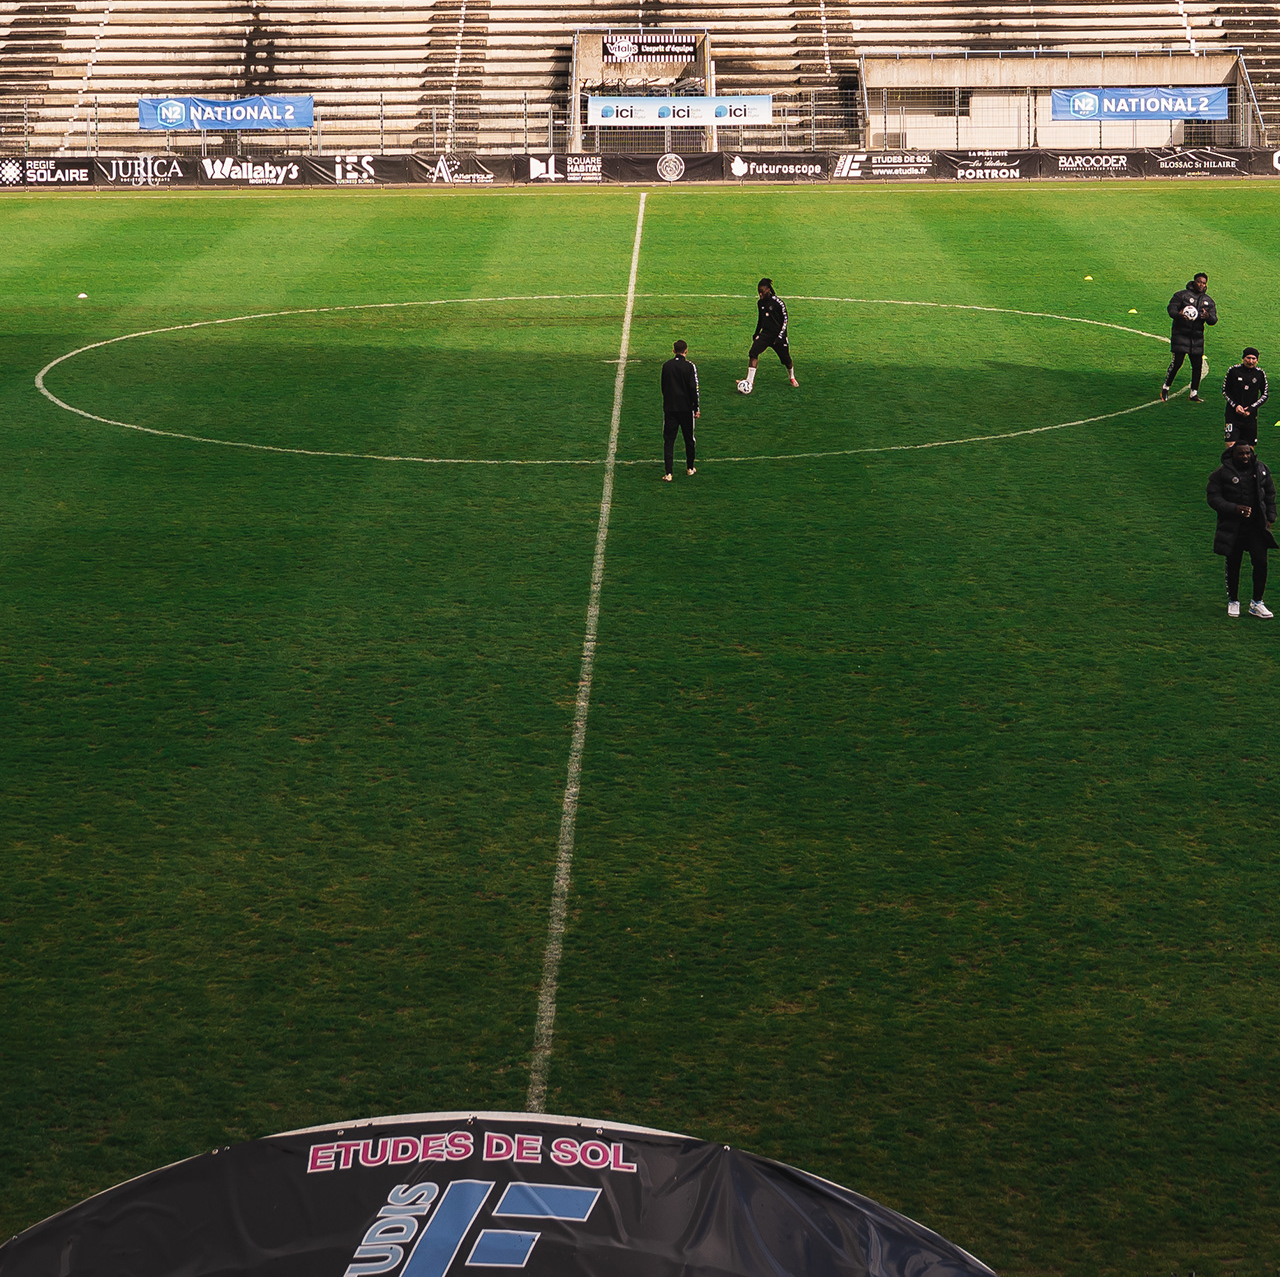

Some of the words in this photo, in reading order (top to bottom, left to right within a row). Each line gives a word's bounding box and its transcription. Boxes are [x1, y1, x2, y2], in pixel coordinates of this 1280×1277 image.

[641, 45, 664, 53] L'esprit
[665, 44, 694, 53] d'équipe
[729, 104, 747, 118] ici
[1074, 98, 1094, 110] N2
[1102, 97, 1197, 112] NATIONAL
[1199, 97, 1209, 111] 2
[161, 106, 181, 119] N2
[190, 105, 282, 121] NATIONAL
[284, 105, 295, 120] 2
[615, 105, 633, 119] ici
[672, 105, 690, 118] ici
[26, 160, 56, 170] REGIE
[567, 157, 602, 165] SQUARE
[872, 156, 902, 164] ETUDES
[915, 155, 932, 163] SOL
[1058, 156, 1127, 167] BAROODER
[1203, 160, 1236, 168] HILAIRE
[108, 159, 183, 181] JURICA
[202, 157, 299, 184] Wallaby's
[567, 164, 602, 172] HABITAT
[749, 162, 821, 175] futuroscope
[872, 167, 928, 176] www.etudis.fr
[957, 168, 1020, 179] PORTRON
[26, 169, 89, 182] SOLAIRE
[307, 1131, 474, 1174] ETUDES
[483, 1131, 543, 1164] DE
[550, 1137, 638, 1173] SOL
